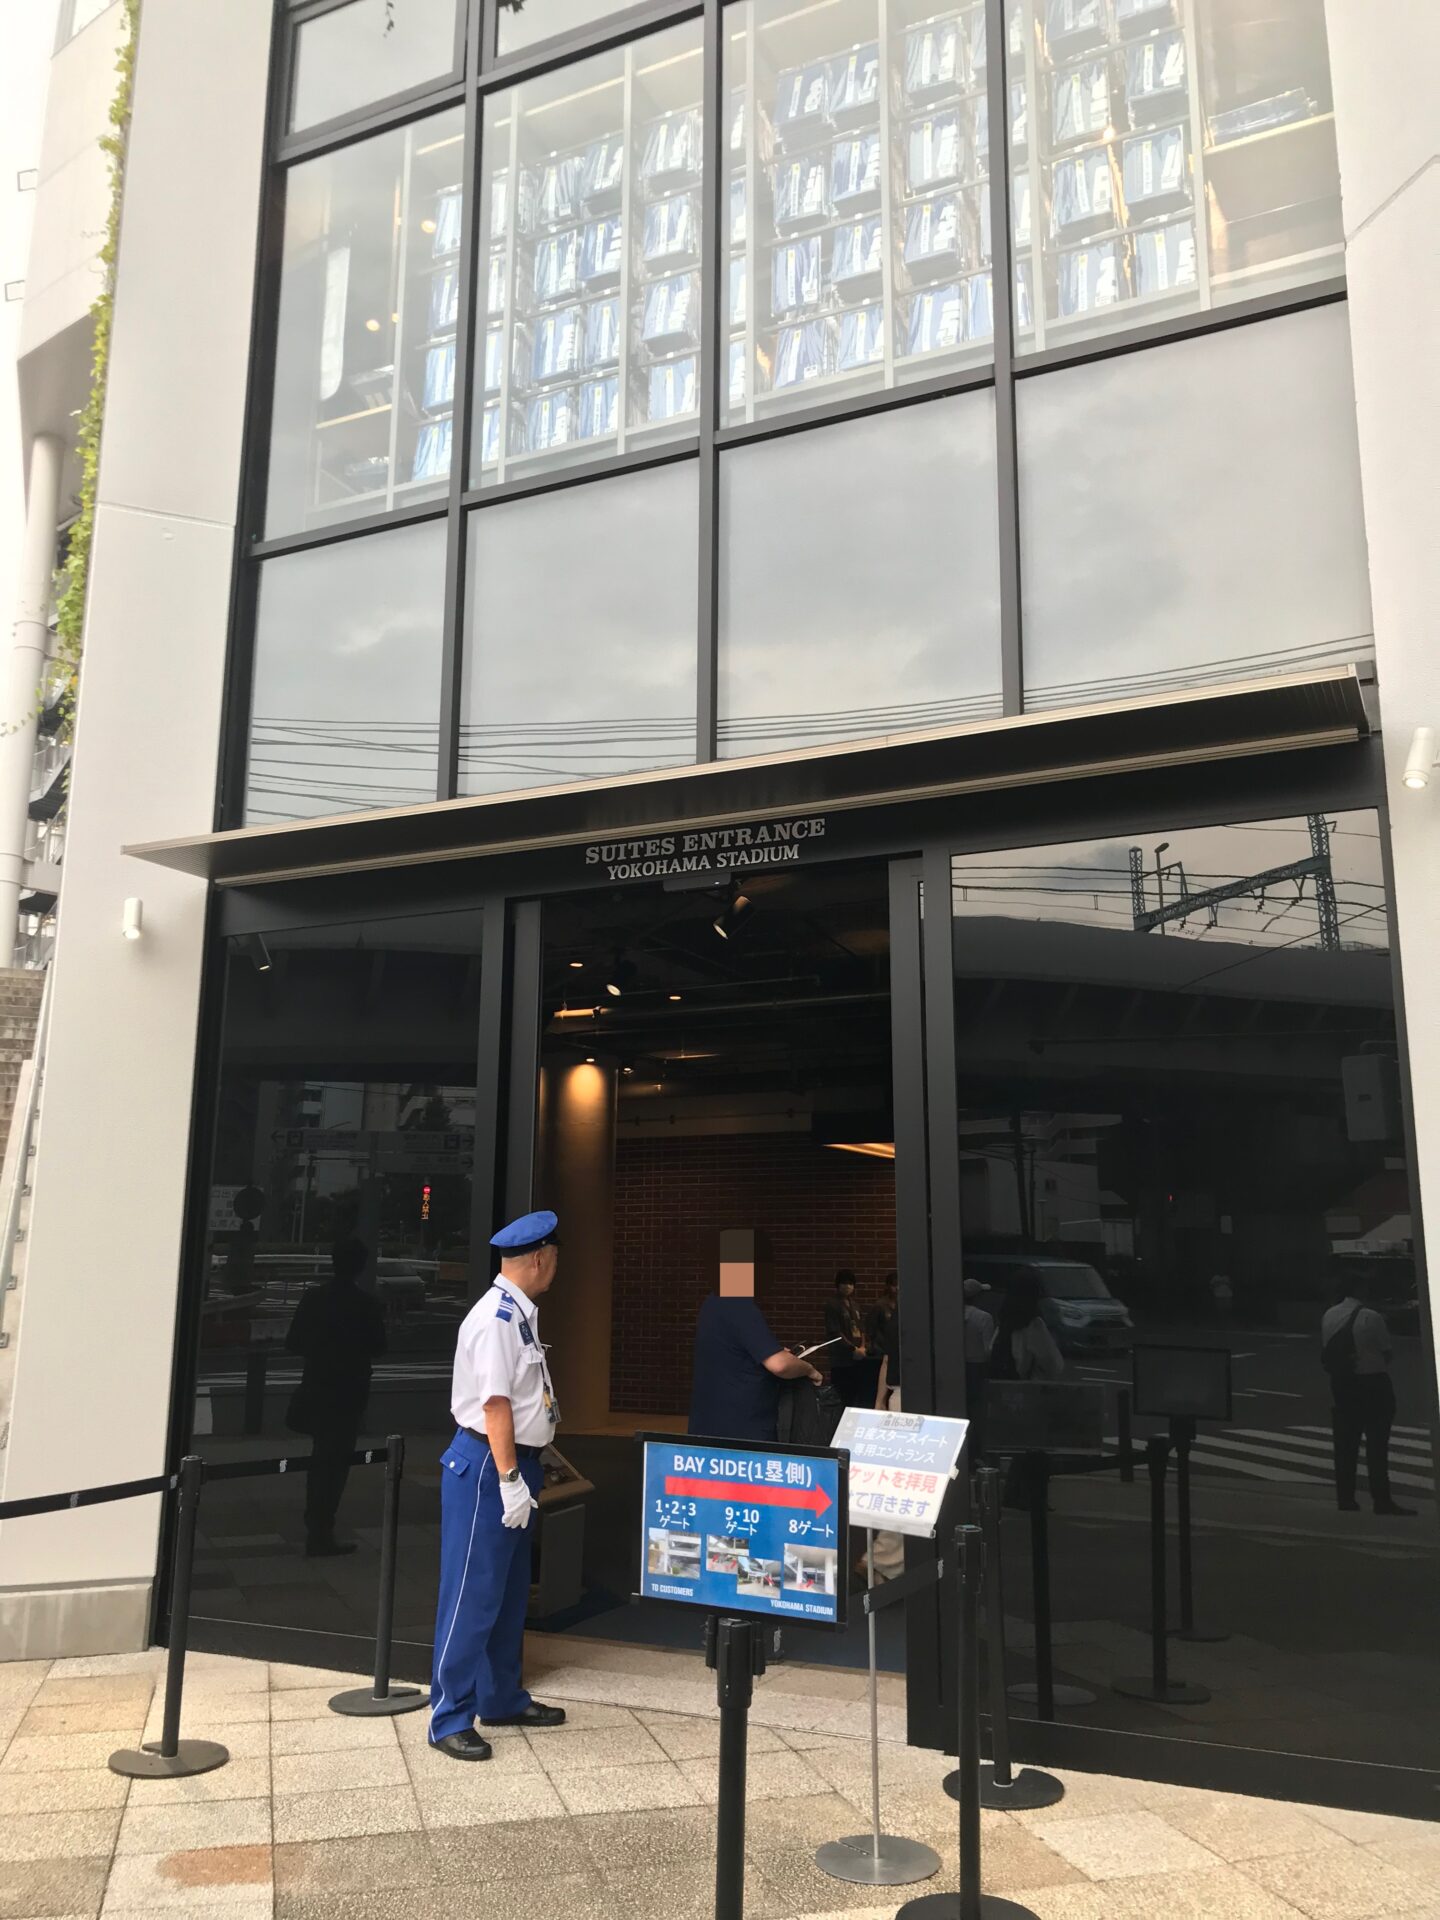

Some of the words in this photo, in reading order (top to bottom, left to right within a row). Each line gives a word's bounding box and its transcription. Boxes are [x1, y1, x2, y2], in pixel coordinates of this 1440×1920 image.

[585, 837, 675, 864] SUITES
[682, 818, 826, 853] ENTRANCE
[607, 856, 711, 881] YOKOHAMA
[716, 843, 800, 868] STADIUM
[854, 1426, 948, 1449] 日産スタースイート
[853, 1443, 935, 1464] 専用エントランス
[673, 1455, 705, 1473] BAY
[849, 1491, 931, 1518] て頂きます
[659, 1515, 690, 1530] ゲート
[725, 1521, 757, 1536] ゲート
[788, 1519, 835, 1539] 8ゲート
[651, 1583, 659, 1592] TO
[659, 1584, 694, 1597] CUSTOMERS
[770, 1599, 804, 1612] YOKOHAMA
[805, 1604, 833, 1616] STADIUM
